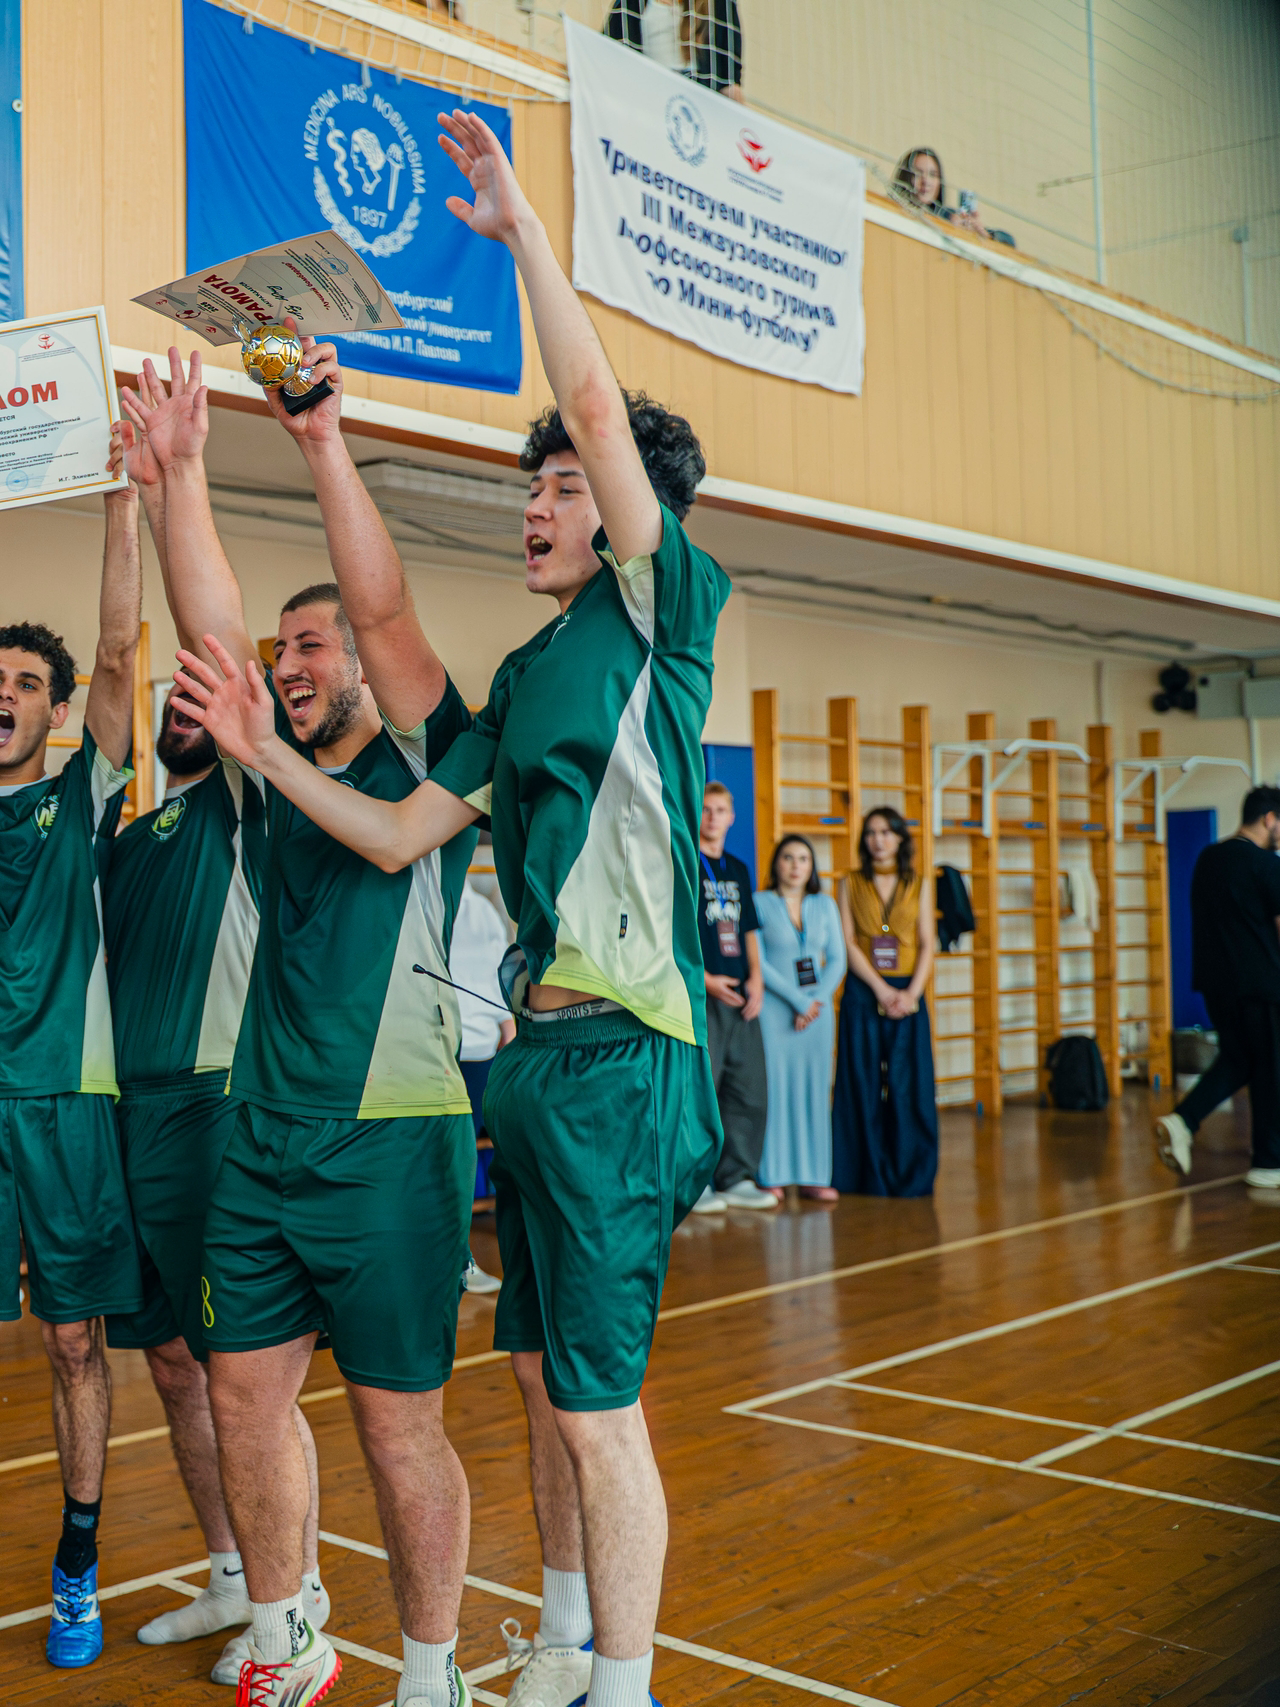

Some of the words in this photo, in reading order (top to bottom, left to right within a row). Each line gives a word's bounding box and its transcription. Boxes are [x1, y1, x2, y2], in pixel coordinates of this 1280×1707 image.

[303, 89, 341, 161] MEDICINA
[342, 83, 368, 104] ARS
[352, 204, 388, 229] 1897
[556, 1003, 590, 1020] SPORTS
[200, 1275, 215, 1328] 8
